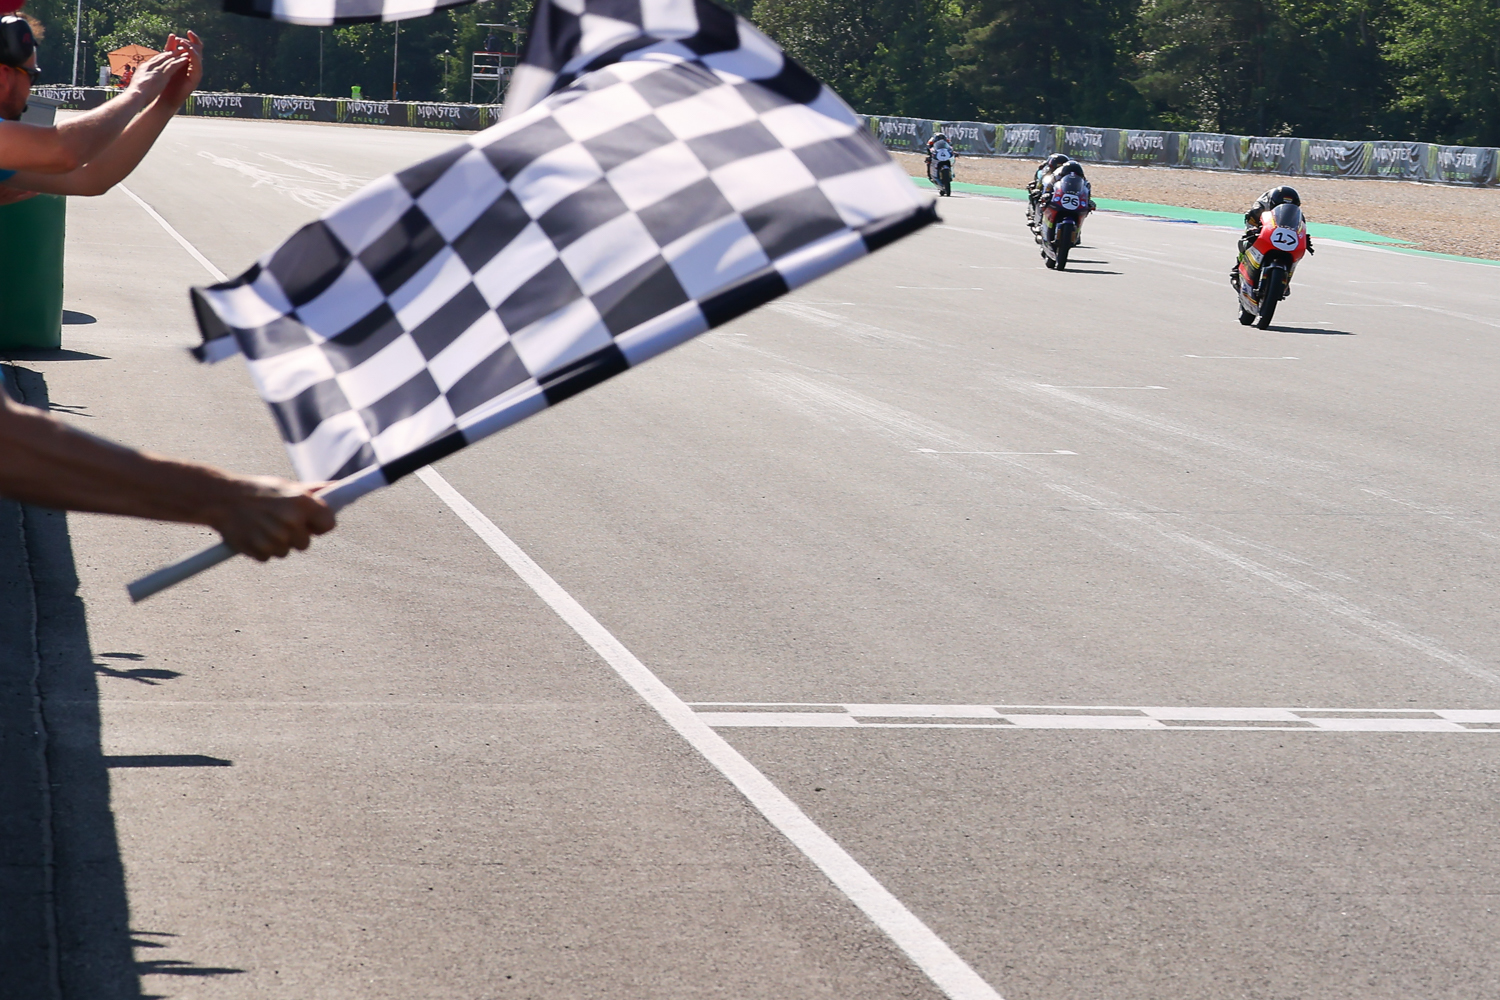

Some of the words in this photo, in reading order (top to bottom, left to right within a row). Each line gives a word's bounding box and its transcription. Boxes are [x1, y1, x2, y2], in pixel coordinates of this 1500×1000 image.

[37, 89, 85, 100] MONSTER
[197, 96, 242, 108] MONSTER
[273, 99, 315, 111] MONSTER
[347, 102, 389, 115] MONSTER
[418, 105, 460, 119] MONSTER
[1063, 196, 1079, 207] 96
[1273, 232, 1296, 246] 17
